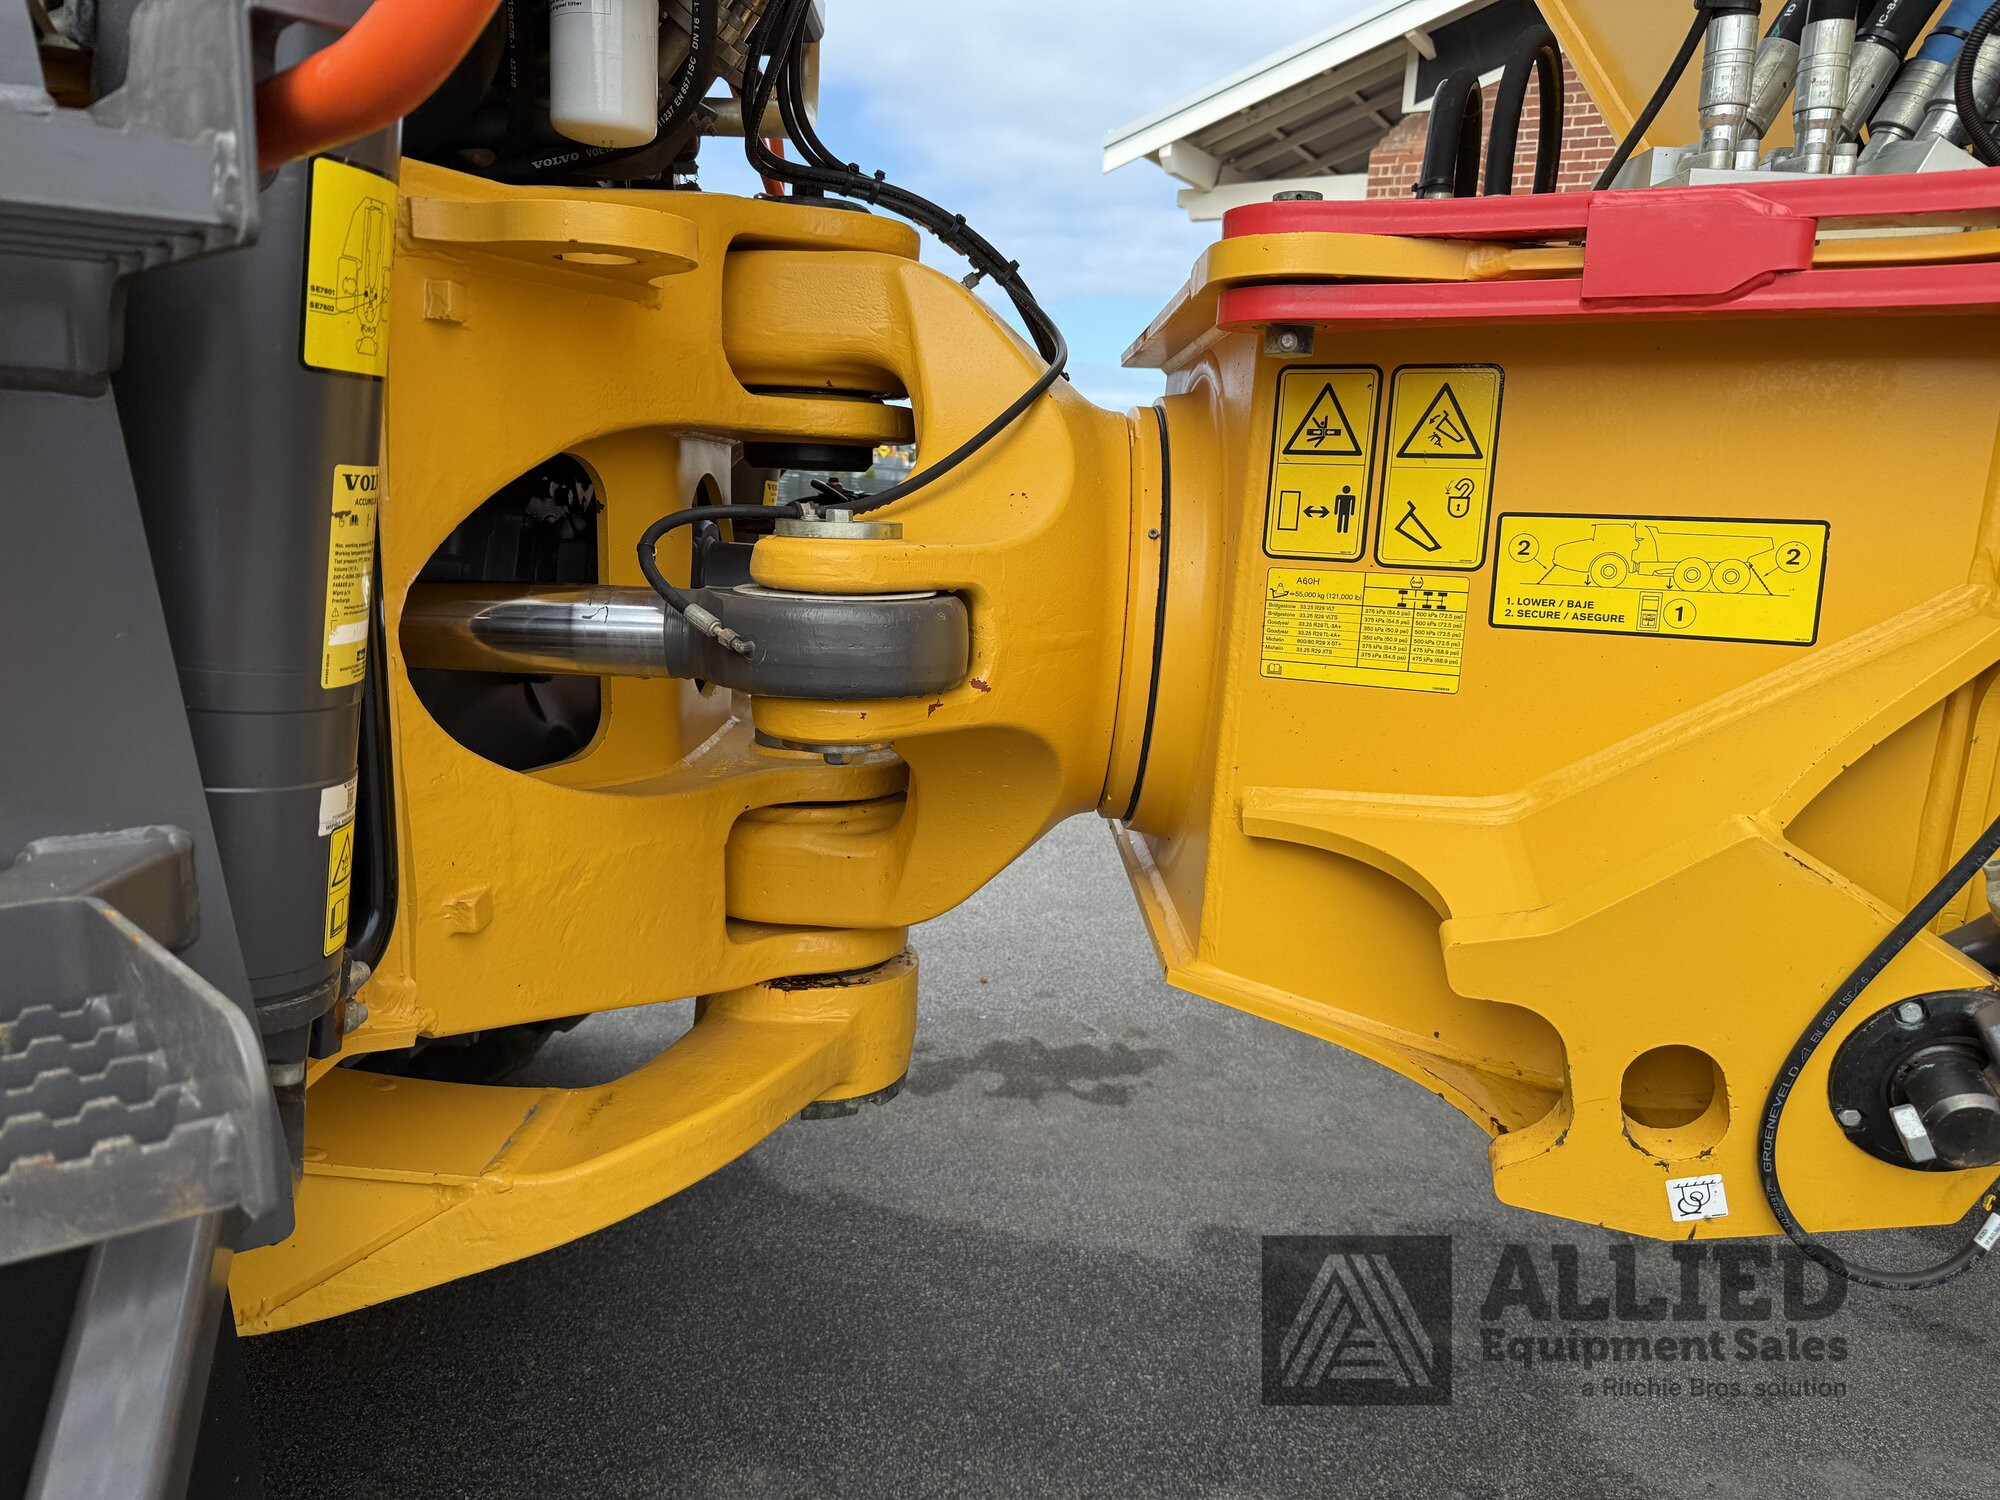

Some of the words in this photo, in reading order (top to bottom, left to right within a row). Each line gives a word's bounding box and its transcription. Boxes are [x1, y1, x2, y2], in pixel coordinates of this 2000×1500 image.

[1784, 3, 1797, 17] ID
[693, 17, 700, 29] 16
[691, 34, 700, 50] DN
[687, 56, 697, 76] 1SC
[681, 78, 691, 95] 857
[674, 92, 684, 106] EN
[531, 152, 579, 169] VOLVO
[343, 474, 378, 491] VOL
[1517, 540, 1530, 555] 2
[1786, 549, 1801, 565] 2
[1507, 597, 1514, 605] 1.
[1517, 598, 1555, 607] LOWER
[1567, 601, 1594, 609] BAJE
[1505, 609, 1514, 617] 2.
[1517, 610, 1560, 619] SECURE
[1572, 613, 1625, 623] ASEGURE
[1675, 606, 1683, 621] 1
[1762, 1065, 1800, 1172] GROENEVELD
[1810, 1030, 1824, 1044] EN
[1822, 1010, 1838, 1029] 857
